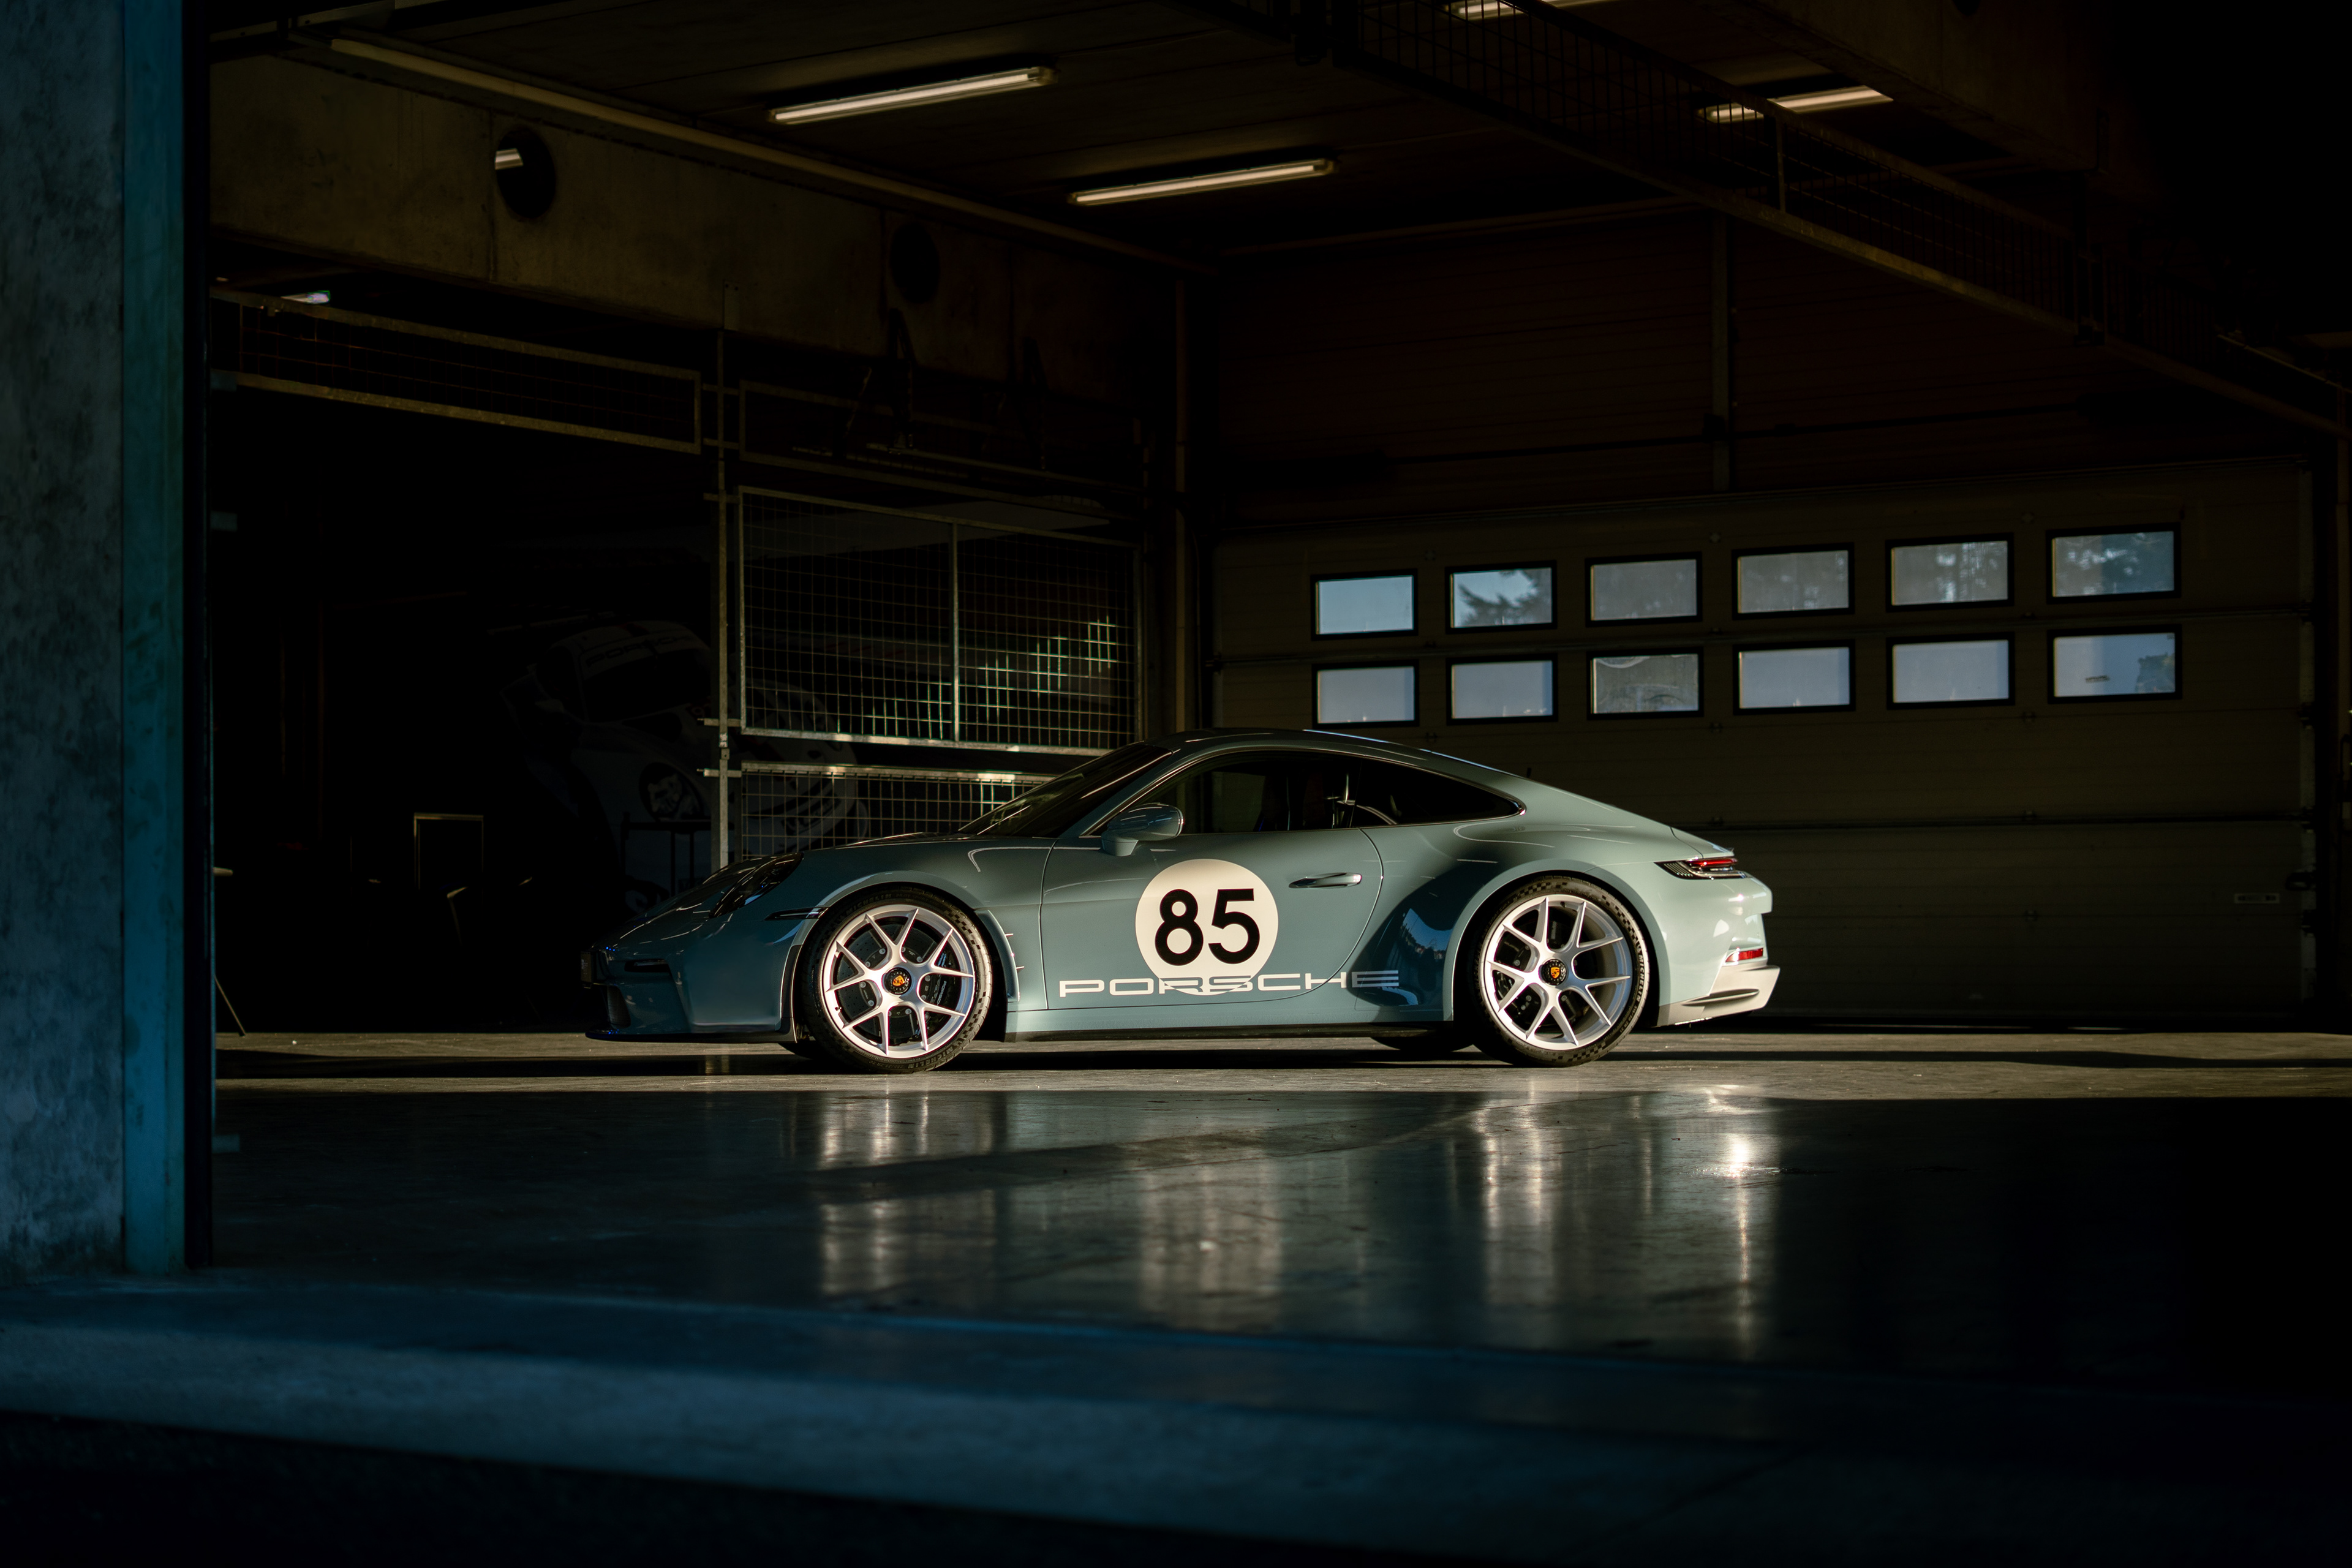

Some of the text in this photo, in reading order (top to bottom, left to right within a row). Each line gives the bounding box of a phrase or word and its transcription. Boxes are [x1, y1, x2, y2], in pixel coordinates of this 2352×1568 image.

[1155, 888, 1260, 965] 85
[1059, 970, 1400, 998] PORSCHE
[1636, 954, 1645, 1002] MICHELIN
[907, 1047, 953, 1069] MICHELIN
